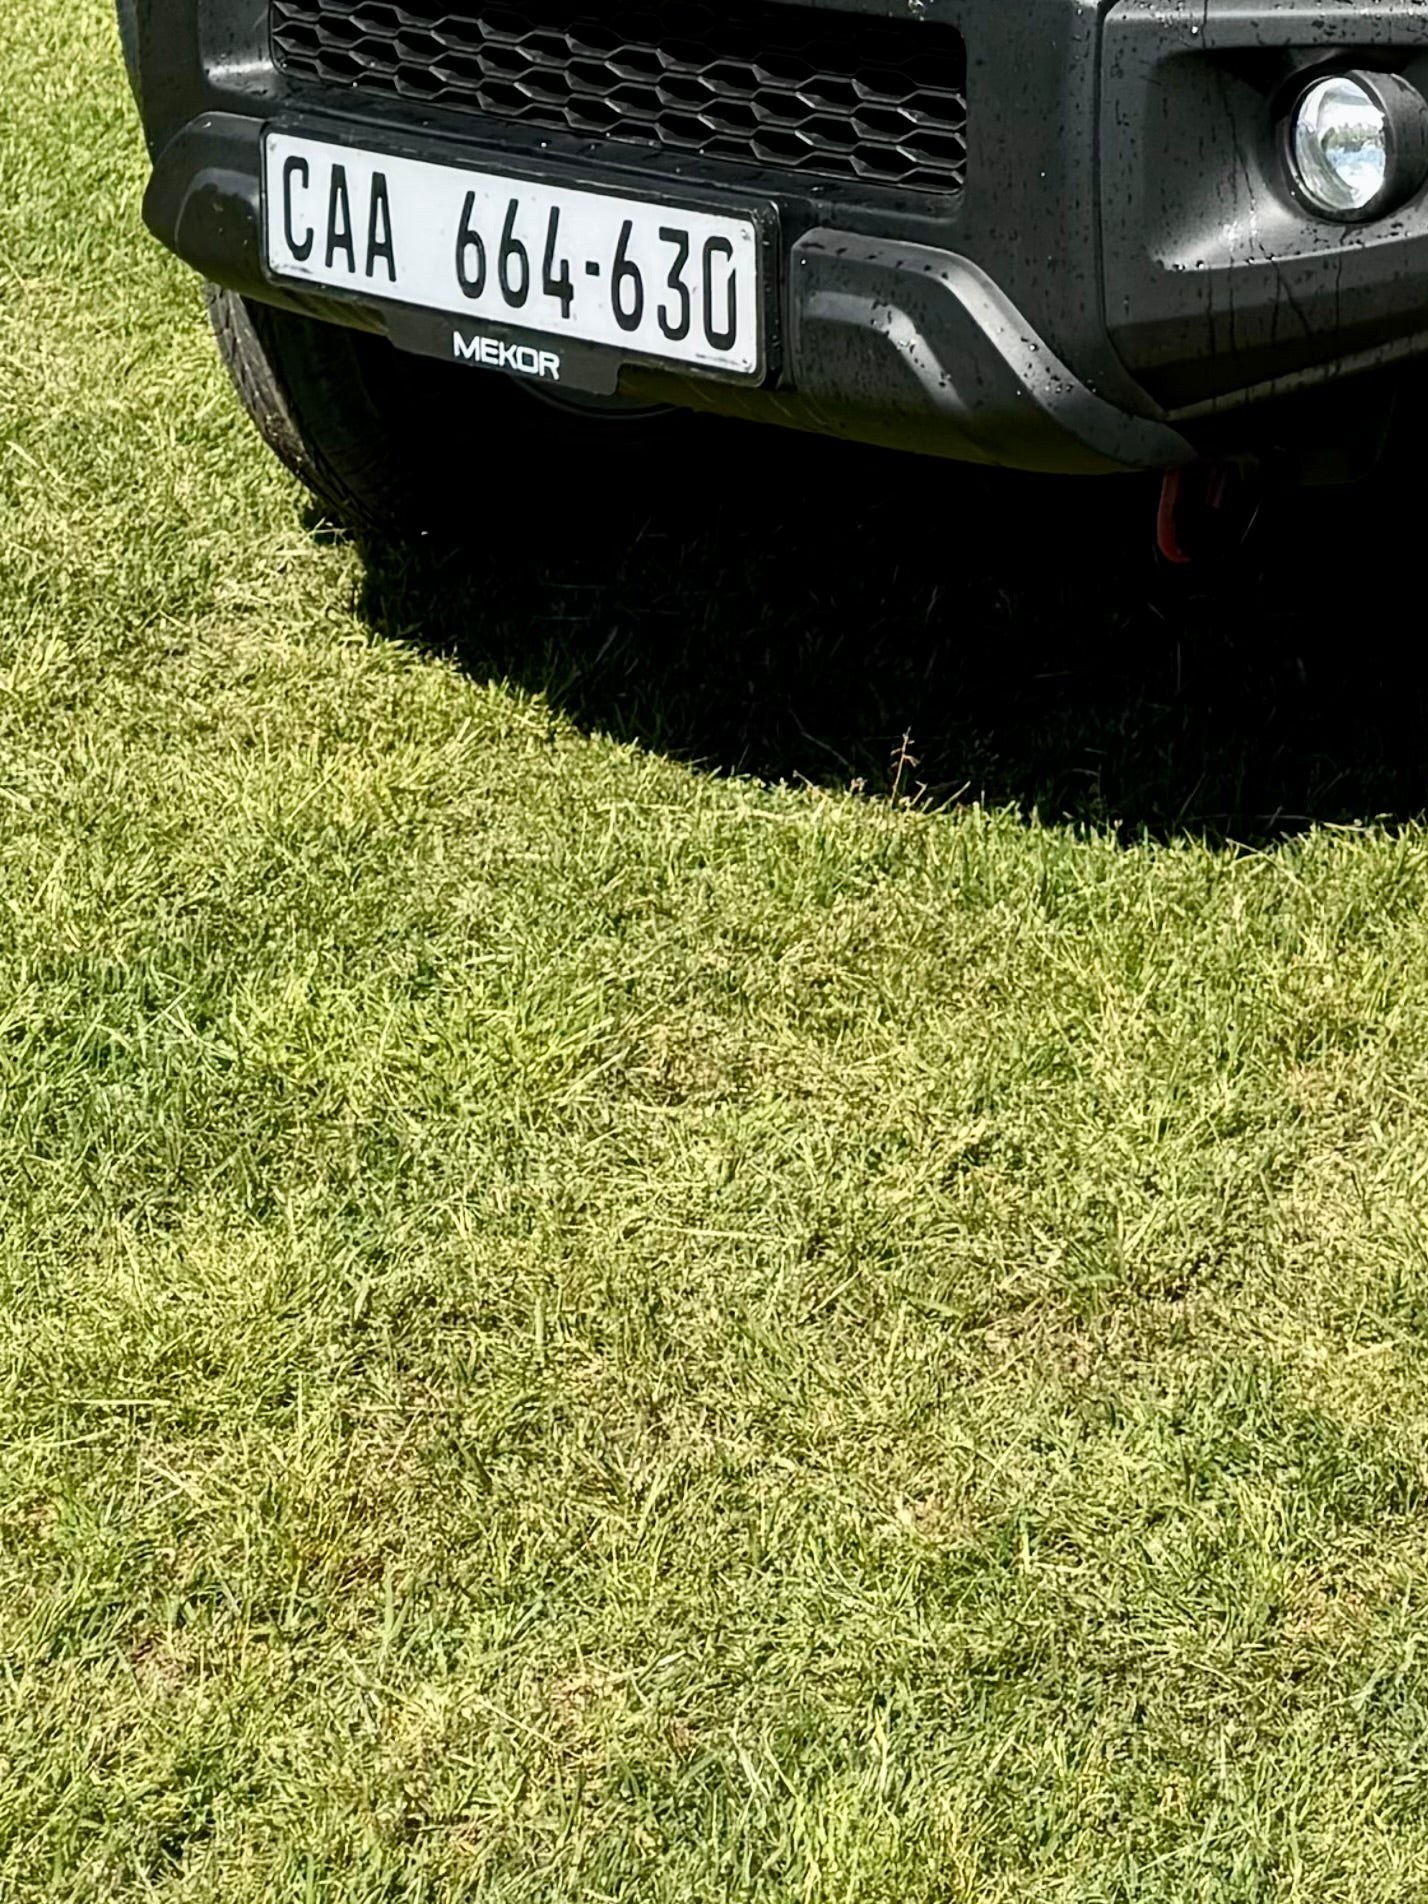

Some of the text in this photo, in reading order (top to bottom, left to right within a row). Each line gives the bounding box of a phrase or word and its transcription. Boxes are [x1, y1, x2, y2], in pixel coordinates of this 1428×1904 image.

[282, 155, 737, 352] CAA 664-630
[452, 330, 561, 381] MEKOR
